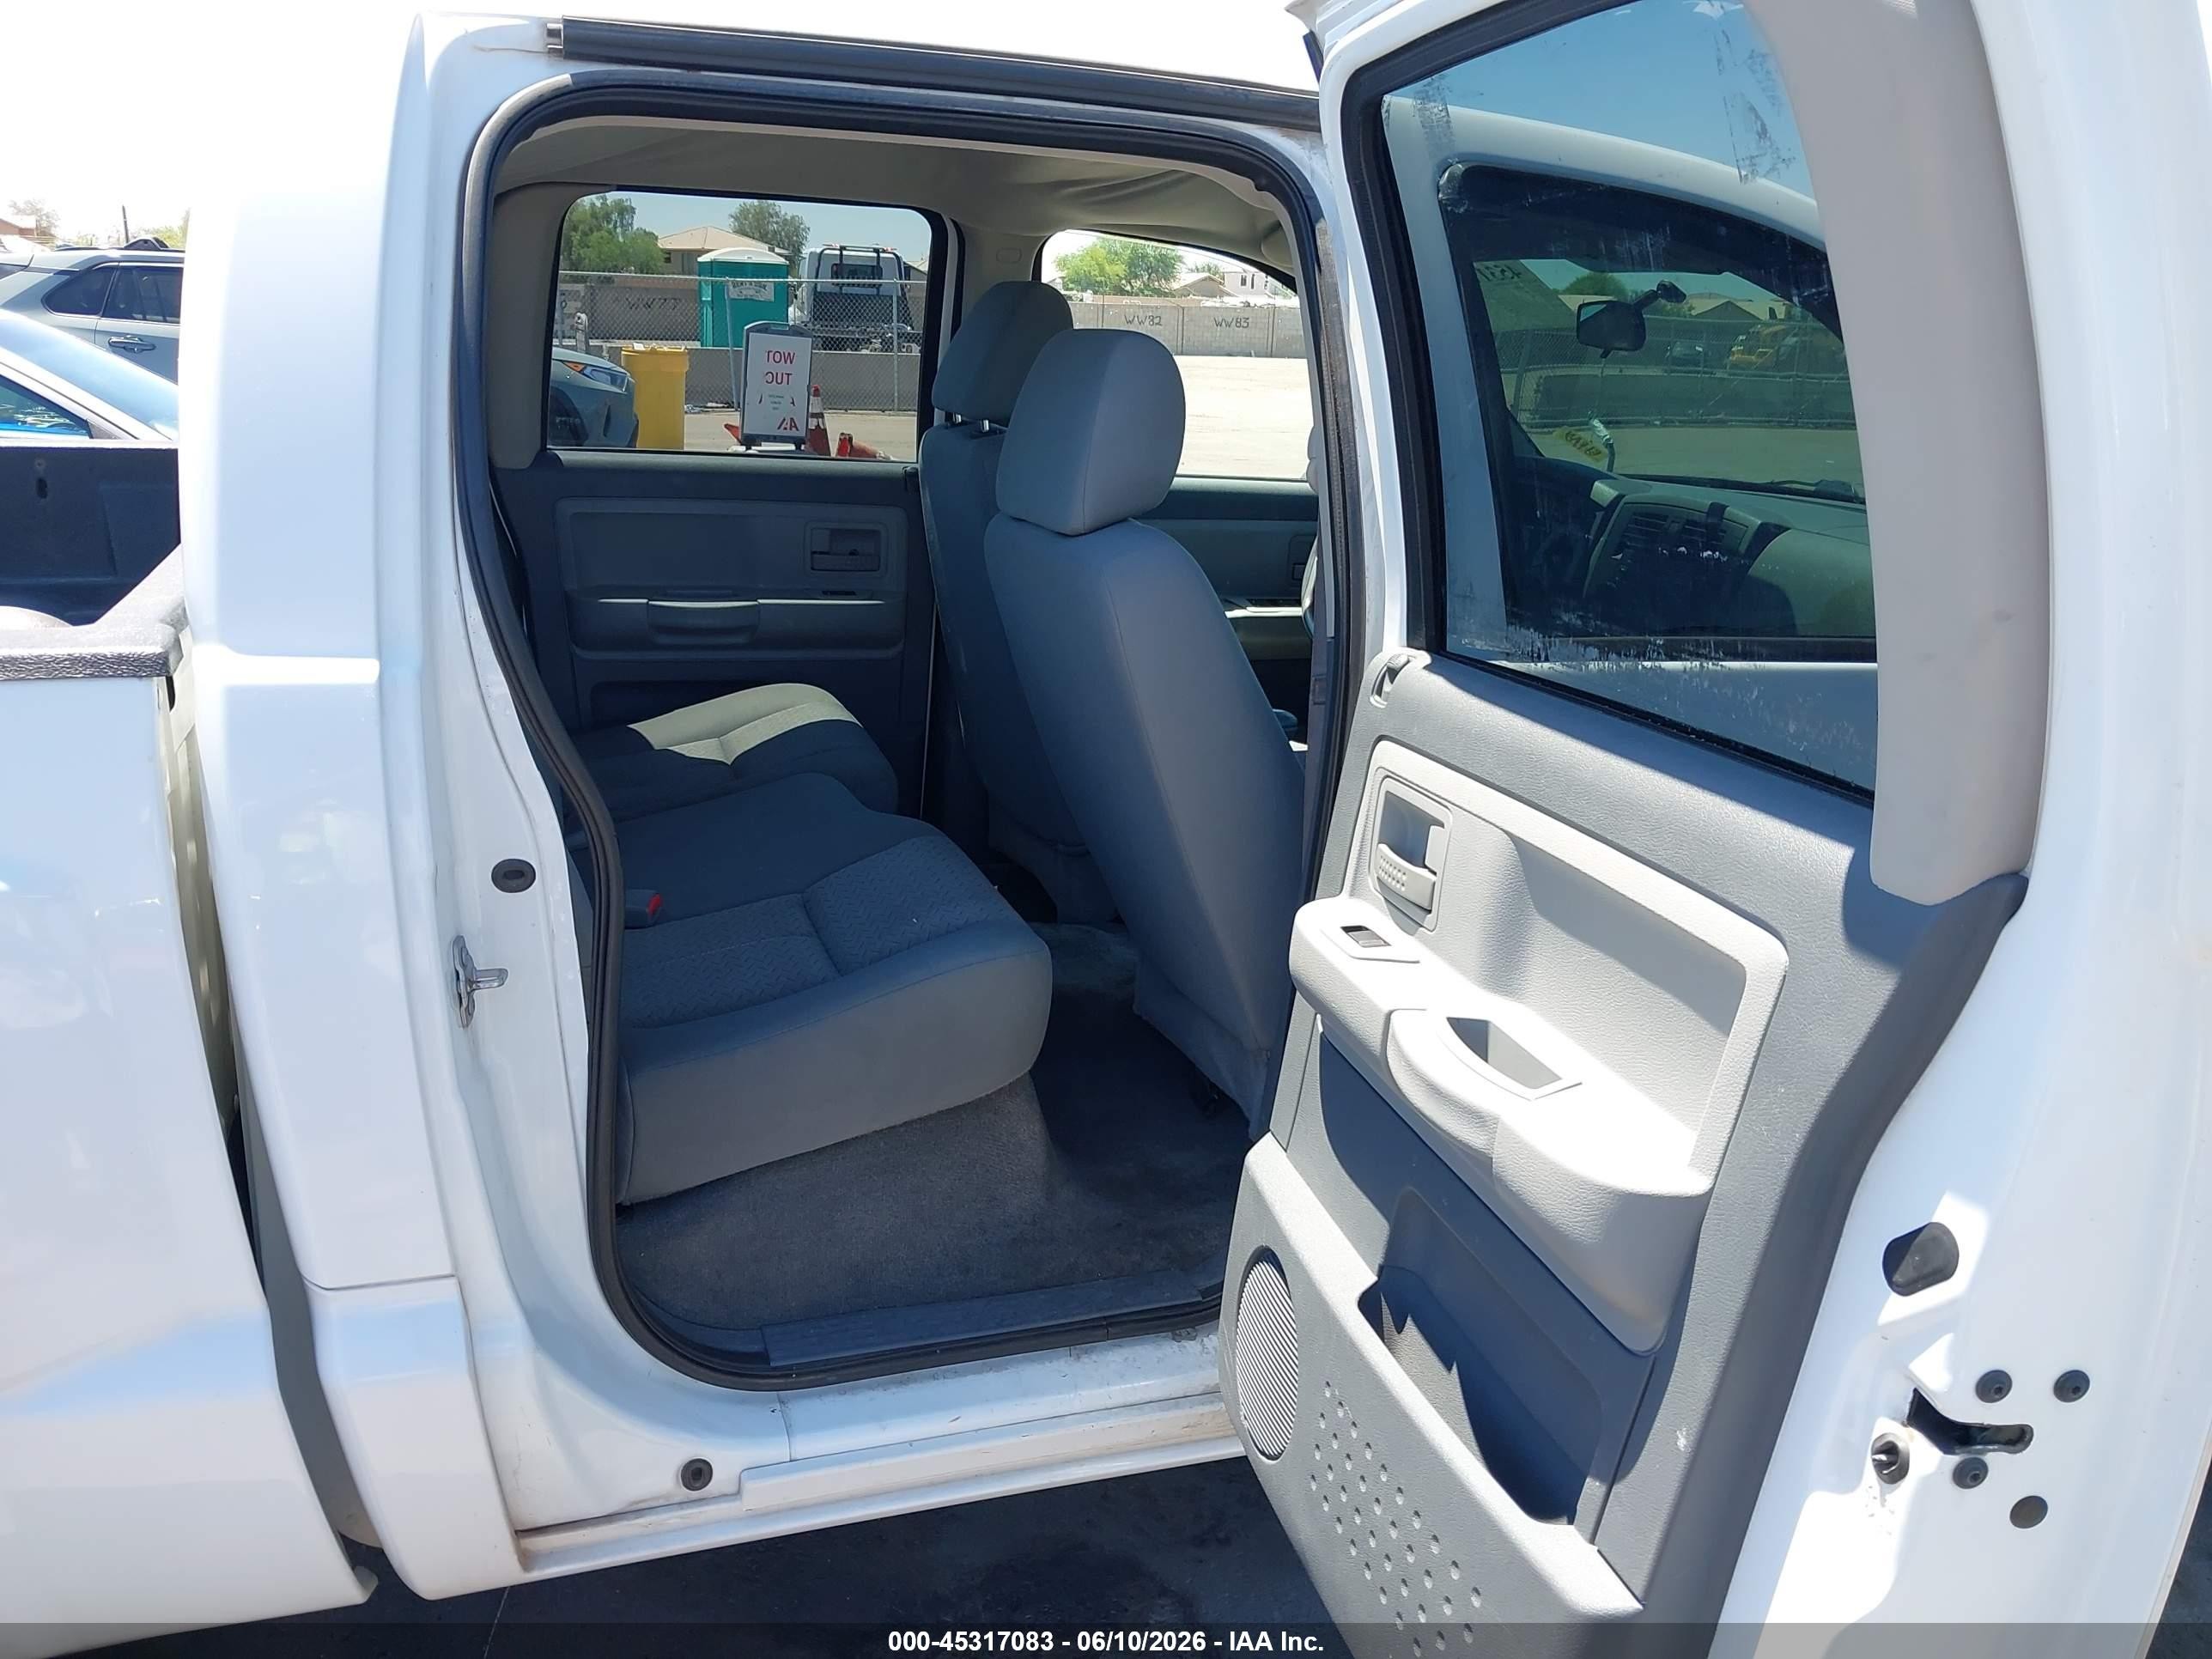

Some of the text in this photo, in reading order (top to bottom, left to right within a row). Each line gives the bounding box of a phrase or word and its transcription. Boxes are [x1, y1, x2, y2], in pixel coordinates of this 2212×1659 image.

[1124, 314, 1163, 326] WW82
[1213, 317, 1250, 328] WW83
[765, 349, 796, 365] TOW
